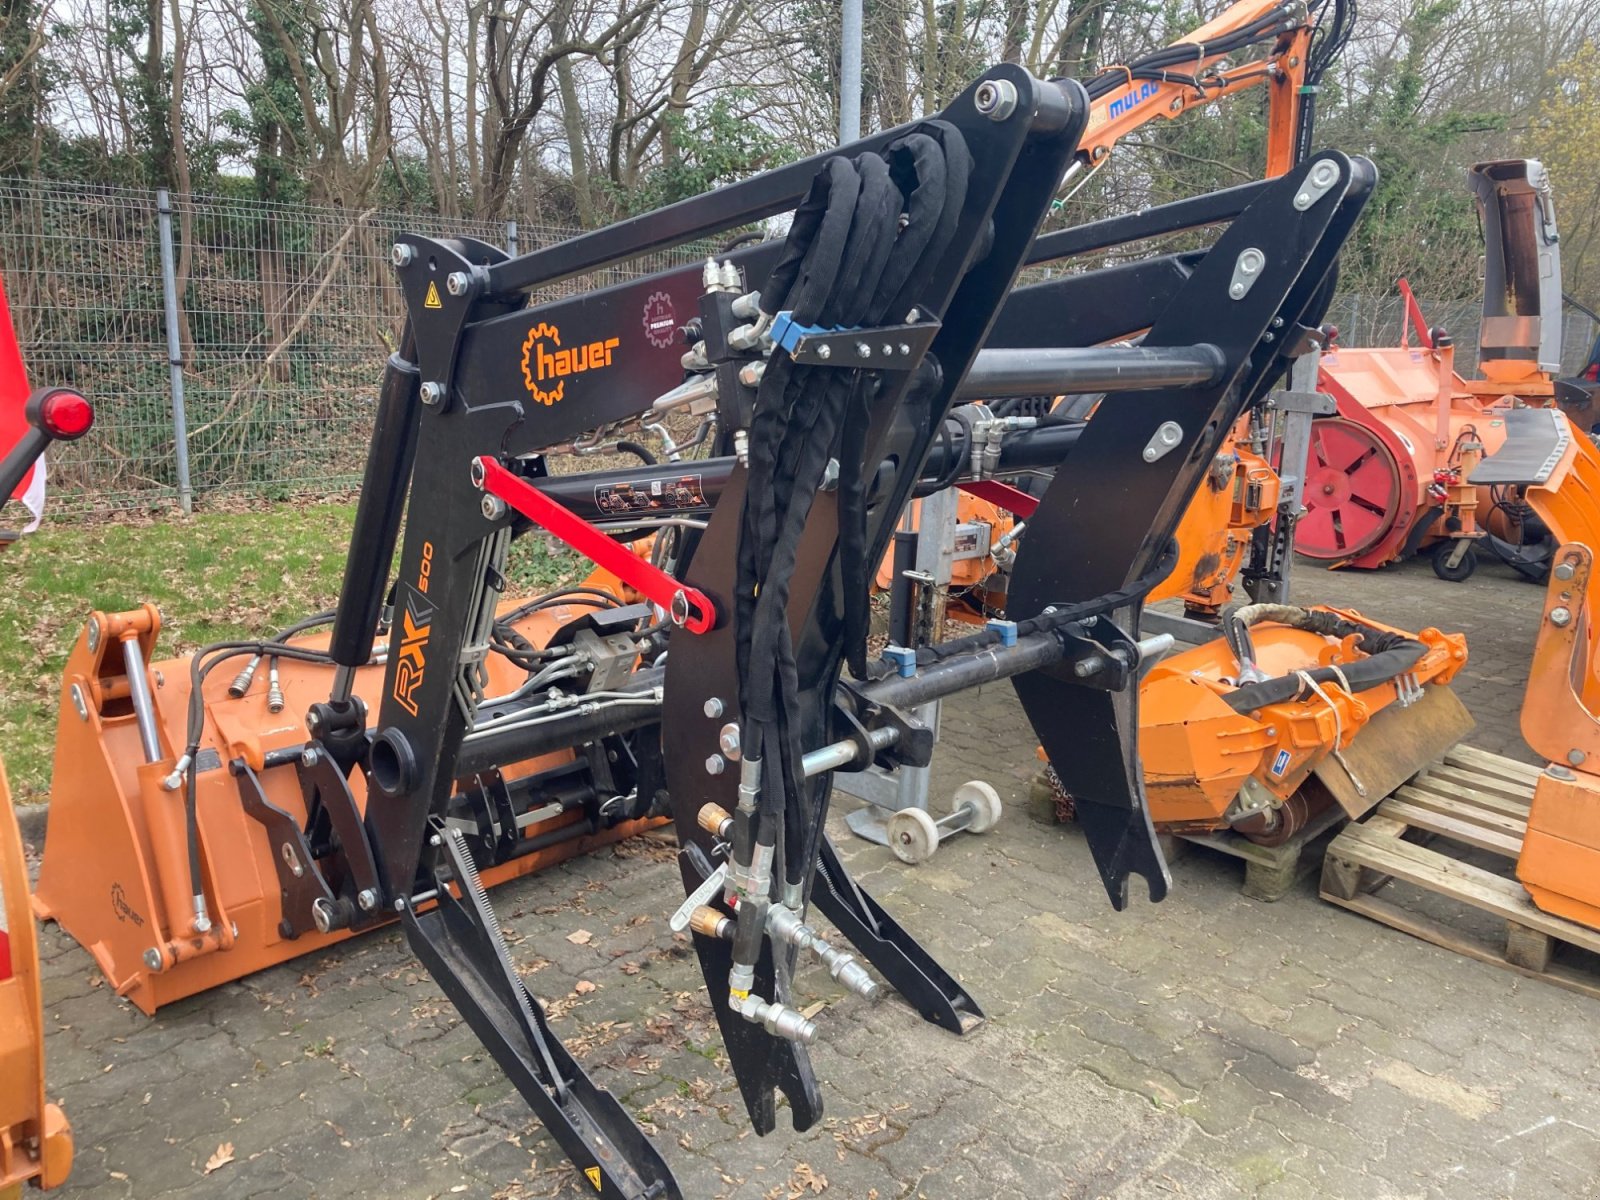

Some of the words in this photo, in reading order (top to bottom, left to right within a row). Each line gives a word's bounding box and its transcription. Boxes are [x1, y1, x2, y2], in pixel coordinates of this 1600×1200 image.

[650, 319, 674, 330] PREMIUM
[536, 338, 620, 381] hauer
[418, 541, 434, 594] 500
[116, 891, 145, 928] hauer
